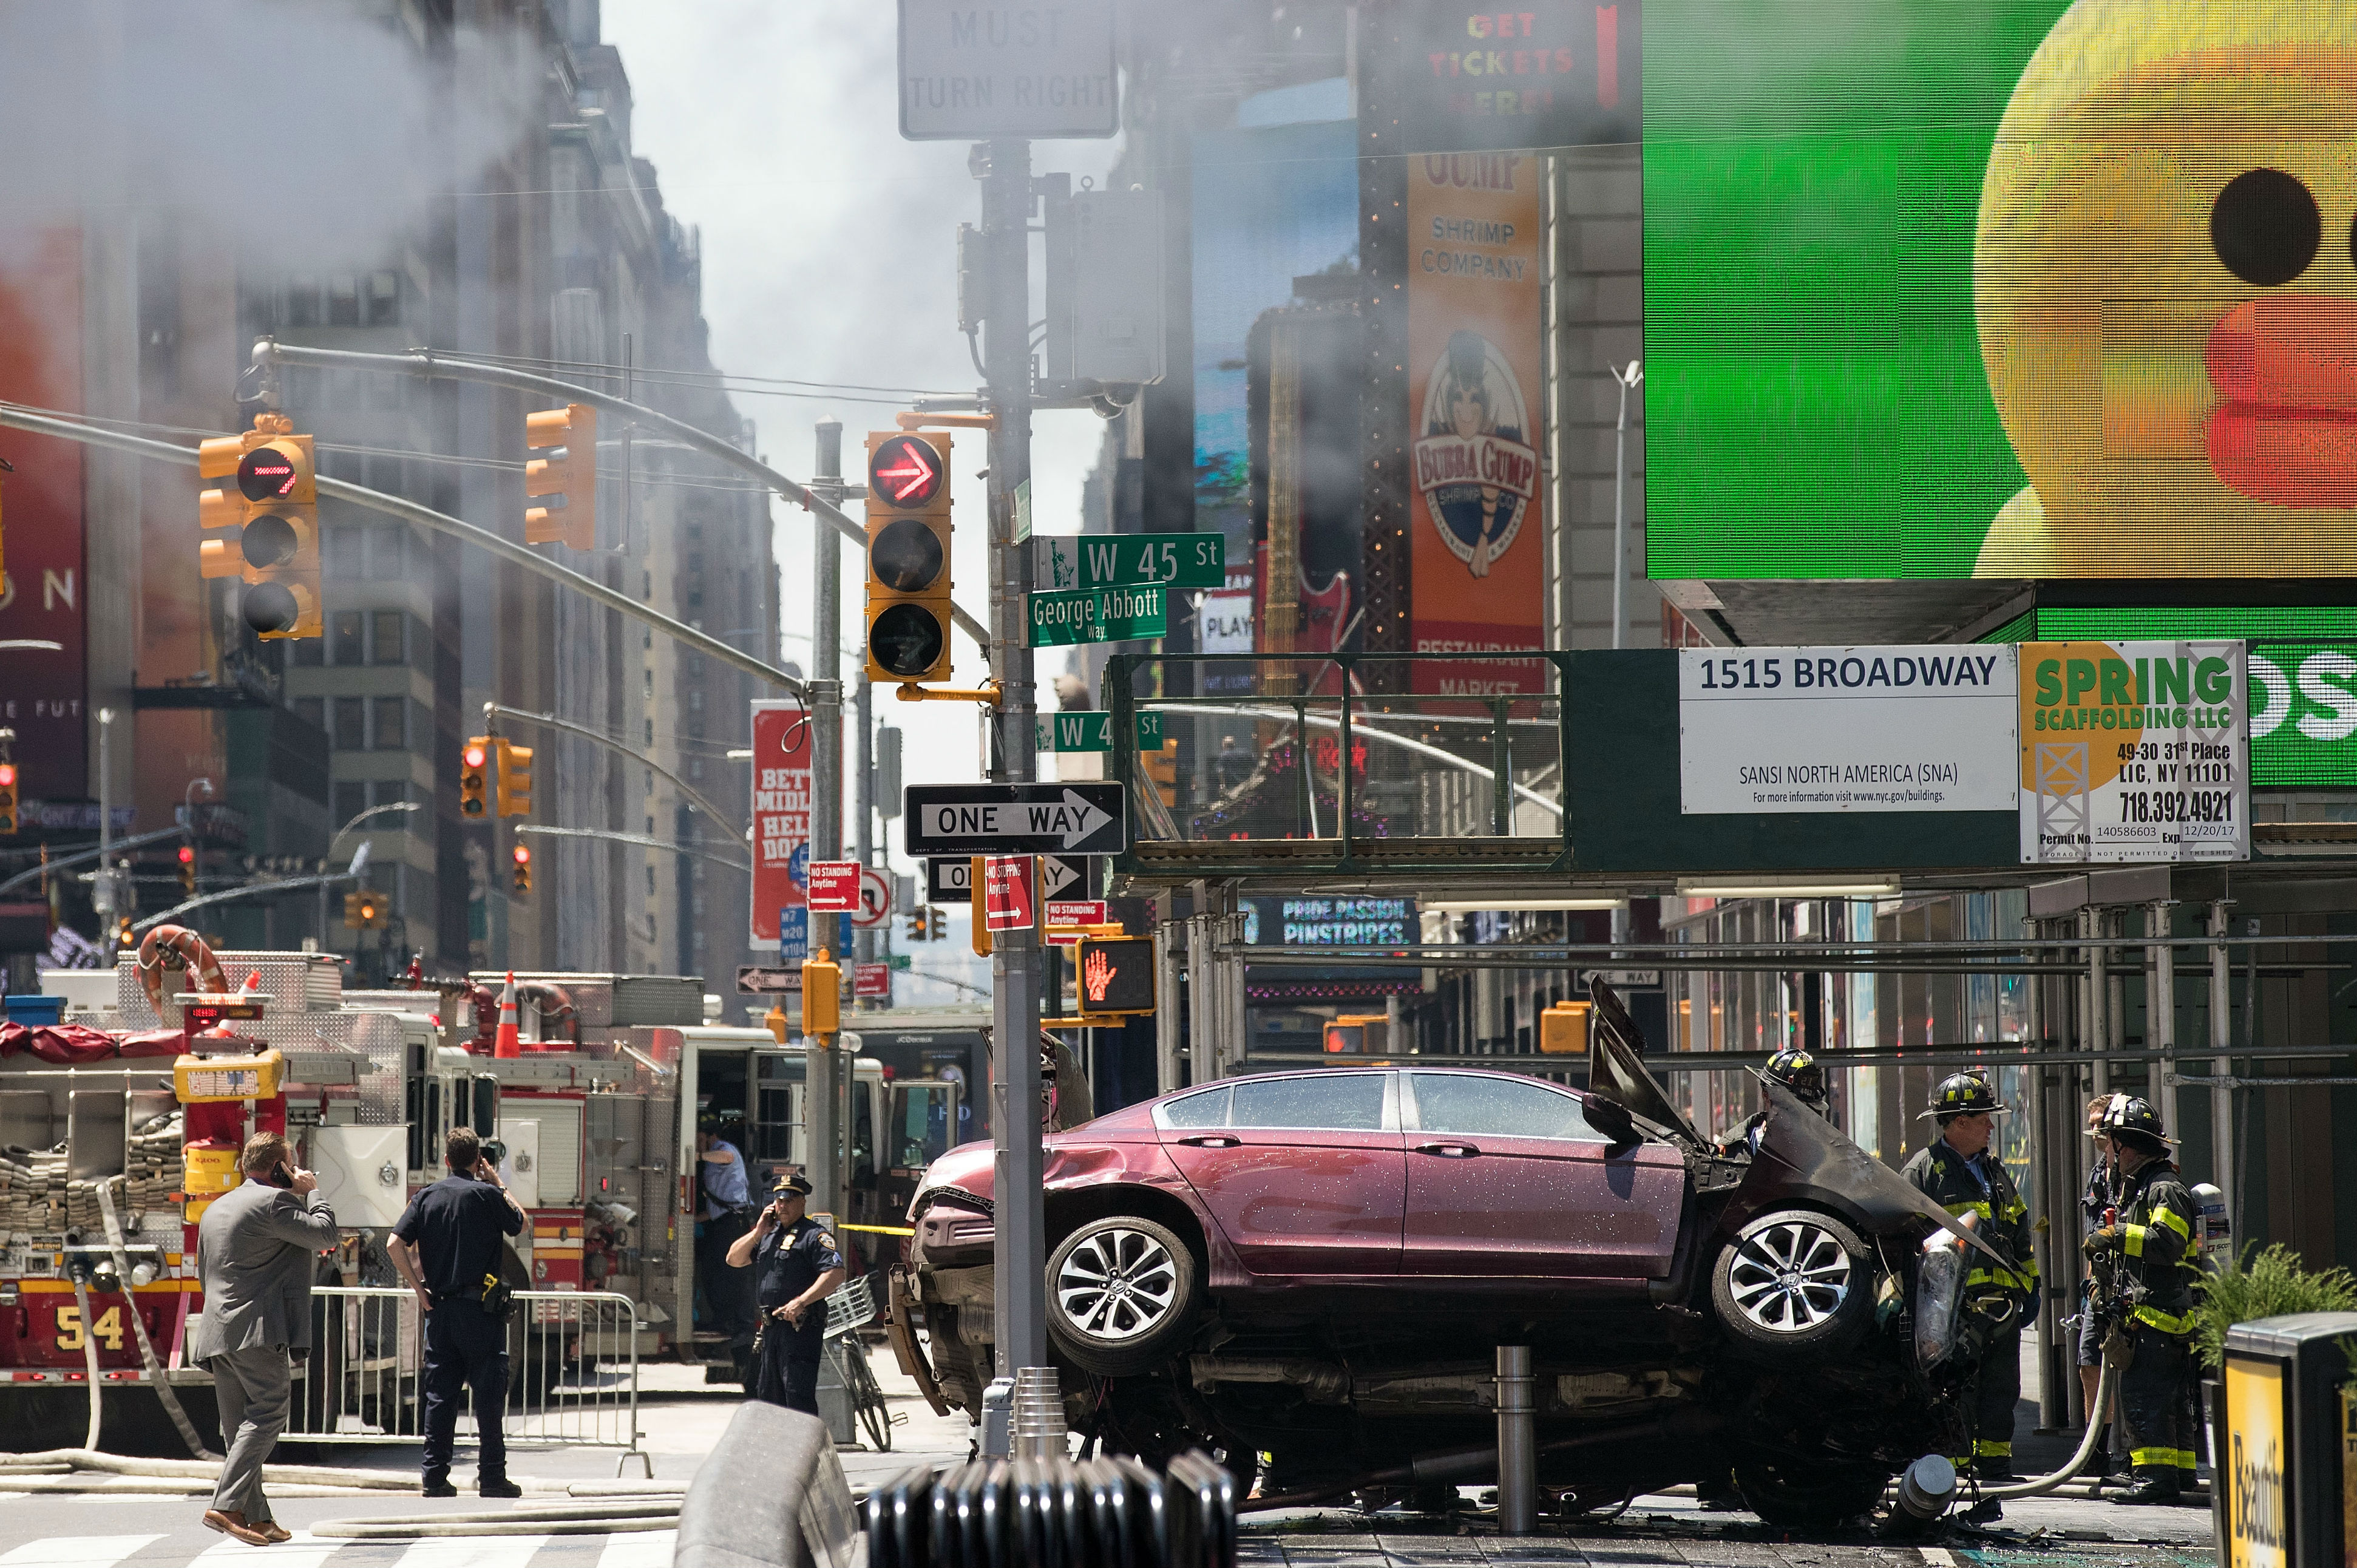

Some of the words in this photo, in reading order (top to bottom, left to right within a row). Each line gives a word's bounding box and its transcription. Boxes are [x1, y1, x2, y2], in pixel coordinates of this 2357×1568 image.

[951, 9, 1063, 49] MUST
[1468, 12, 1535, 38] GET
[1429, 48, 1573, 77] TICKETS
[909, 76, 993, 108] TURN
[1015, 75, 1109, 107] RIGHT
[1432, 216, 1514, 246] SHRIMP
[1420, 249, 1527, 283] COMPANY
[1088, 544, 1117, 582] W
[1138, 542, 1178, 582] 45
[1196, 541, 1218, 566] St
[1034, 596, 1094, 630] George
[1102, 588, 1159, 620] Abbott
[1087, 623, 1105, 641] Way
[1701, 658, 1782, 690] 1515
[1794, 656, 1997, 688] BROADWAY
[2035, 656, 2232, 707] SPRING
[2034, 708, 2189, 731] SCAFFOLDING
[2194, 706, 2231, 729] LLC
[1061, 718, 1084, 747] W
[1098, 718, 1113, 746] 4
[1142, 716, 1158, 735] St
[2117, 742, 2159, 761] 49-30
[2164, 739, 2190, 759] 31st
[2191, 742, 2230, 760] Place
[1739, 765, 1783, 785] SANSI
[1787, 765, 1840, 784] NORTH
[1843, 764, 1913, 783] AMERICA
[1917, 762, 1958, 787] (SNA)
[2119, 764, 2151, 785] LIC,
[2158, 764, 2179, 783] NY
[2185, 763, 2231, 782] 11101
[755, 791, 810, 812] MIDL
[1752, 792, 1766, 803] For
[1767, 793, 1788, 803] more
[1788, 790, 1834, 803] information
[1835, 790, 1852, 803] visit
[1853, 789, 1945, 805] www.nyc.gov/buildings.
[2120, 791, 2232, 823] 718.392.4921
[762, 815, 810, 838] HEL
[938, 807, 999, 834] ONE
[1028, 806, 1091, 833] WAY
[2098, 825, 2157, 838] 140586603
[2185, 824, 2234, 838] 12/20/17
[2040, 833, 2075, 846] Permit
[2077, 832, 2094, 845] No.
[2162, 832, 2183, 846] Exp.
[811, 867, 820, 877] NO
[821, 867, 852, 877] STANDING
[988, 865, 996, 878] NO
[997, 863, 1021, 878] STOPPING
[811, 878, 837, 889] Anytime
[988, 881, 1009, 898] Anytime
[1050, 905, 1060, 915] NO
[1061, 905, 1096, 915] STANDING
[1050, 915, 1079, 925] Anytime
[748, 976, 772, 986] ONE
[785, 975, 802, 986] WA
[1626, 972, 1653, 983] WAY
[1800, 1077, 1813, 1086] 21
[57, 1305, 124, 1351] 54
